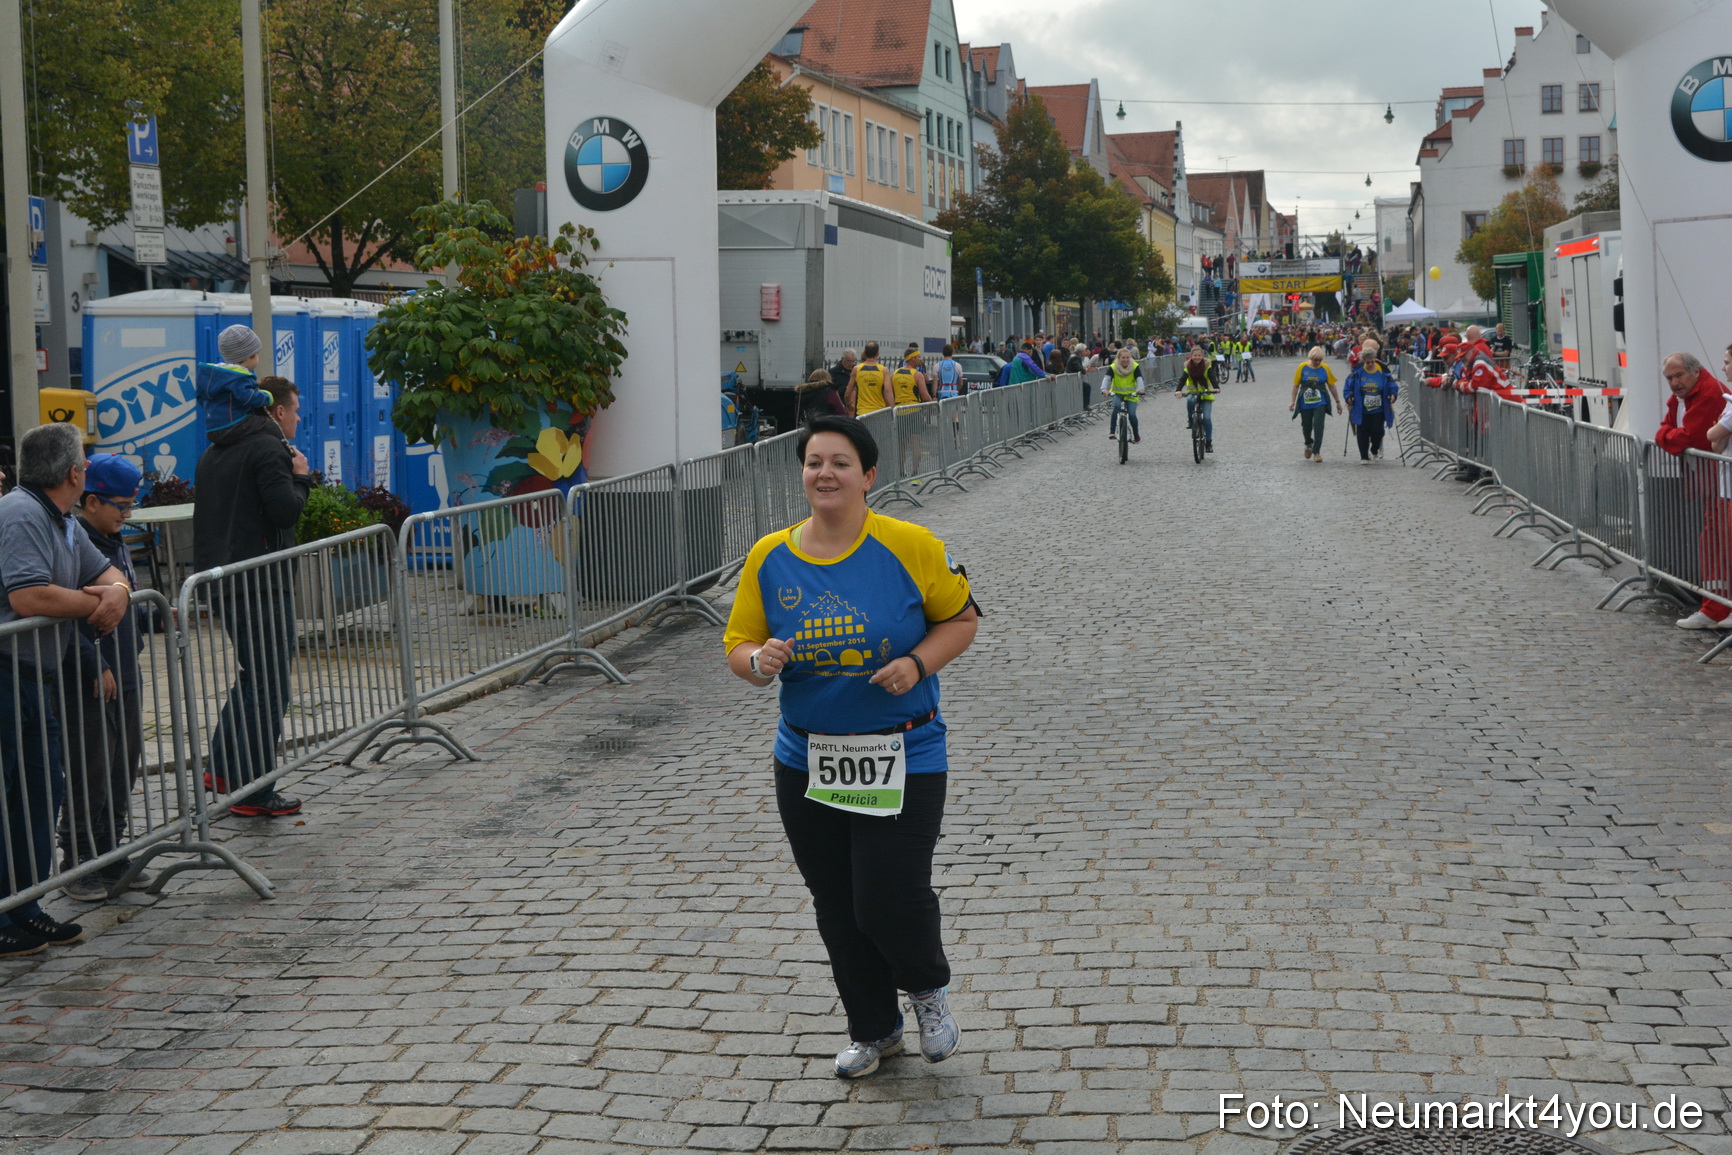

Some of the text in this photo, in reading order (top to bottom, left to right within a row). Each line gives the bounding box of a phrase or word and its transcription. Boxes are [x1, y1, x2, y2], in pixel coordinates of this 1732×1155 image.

[133, 112, 150, 156] P
[569, 118, 642, 150] BMW
[133, 180, 159, 190] Parkschein
[136, 191, 158, 202] werktags
[924, 265, 946, 299] BOCK
[1272, 280, 1308, 289] START
[810, 742, 887, 753] PARTL Neumarkt
[819, 755, 896, 785] 5007
[831, 793, 878, 805] Patricia
